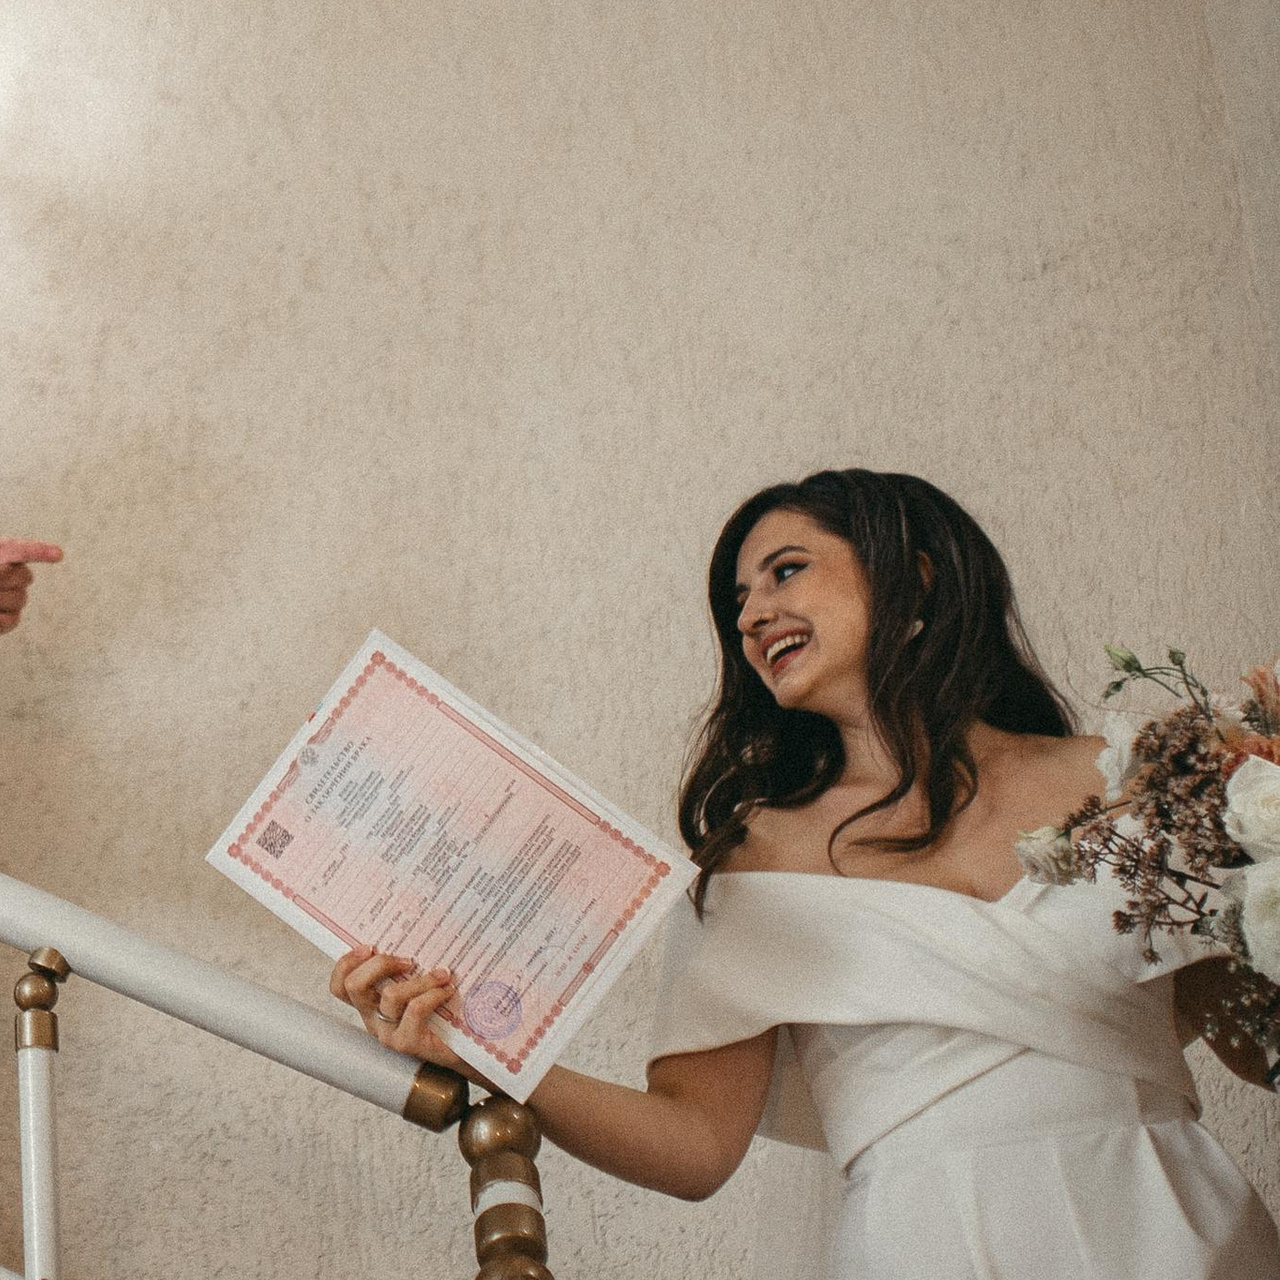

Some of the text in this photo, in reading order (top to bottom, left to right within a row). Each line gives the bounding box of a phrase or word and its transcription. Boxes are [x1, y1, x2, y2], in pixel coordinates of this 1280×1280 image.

[303, 739, 355, 805] СВИДЕТЕЛЬСТВО
[309, 759, 353, 815] ЗАКЛЮЧЕНИИ
[349, 734, 372, 761] БРАКА
